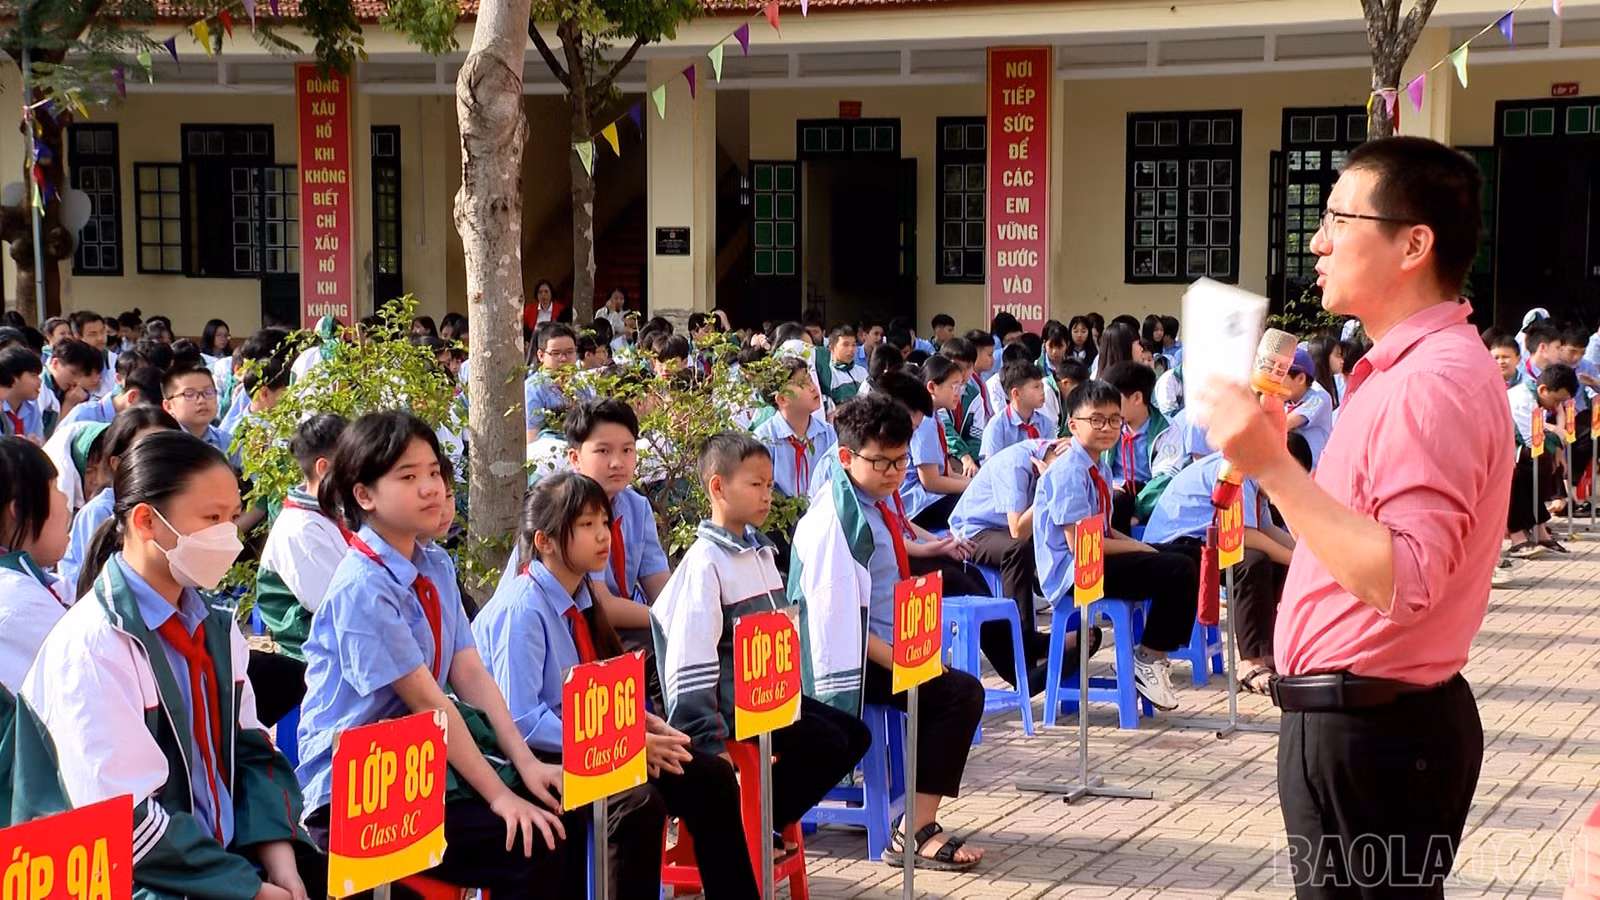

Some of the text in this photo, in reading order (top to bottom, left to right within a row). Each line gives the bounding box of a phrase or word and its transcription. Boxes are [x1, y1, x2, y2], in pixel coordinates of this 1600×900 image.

[1006, 61, 1033, 78] NƠI
[1003, 84, 1035, 106] TIẾP
[311, 97, 336, 116] XẤU
[316, 120, 333, 139] HỔ
[1003, 113, 1034, 133] SỨC
[315, 147, 335, 161] KHI
[1009, 137, 1030, 160] ĐỂ
[305, 168, 346, 184] KHÔNG
[1003, 168, 1034, 187] CÁC
[313, 189, 339, 206] BIẾT
[1006, 197, 1029, 214] EM
[316, 212, 337, 229] CHỈ
[997, 221, 1039, 240] VỮNG
[315, 235, 339, 250] XẤU
[319, 254, 335, 273] HỔ
[997, 248, 1038, 268] BƯỚC
[317, 281, 337, 295] KHI
[1003, 274, 1033, 294] VÀO
[307, 301, 348, 317] KHÔNG
[1078, 528, 1100, 568] LỚP 6C
[901, 591, 938, 641] LỚP 6D
[743, 626, 793, 682] LỚP 6E
[905, 639, 932, 663] Class 6D
[751, 679, 786, 706] Class 6E
[574, 677, 636, 743] LỚP 6G
[584, 736, 628, 770] Class 6G
[347, 739, 435, 819] LỚP 8C
[360, 809, 421, 851] Class 8C
[3, 838, 112, 900] ỚP 9A
